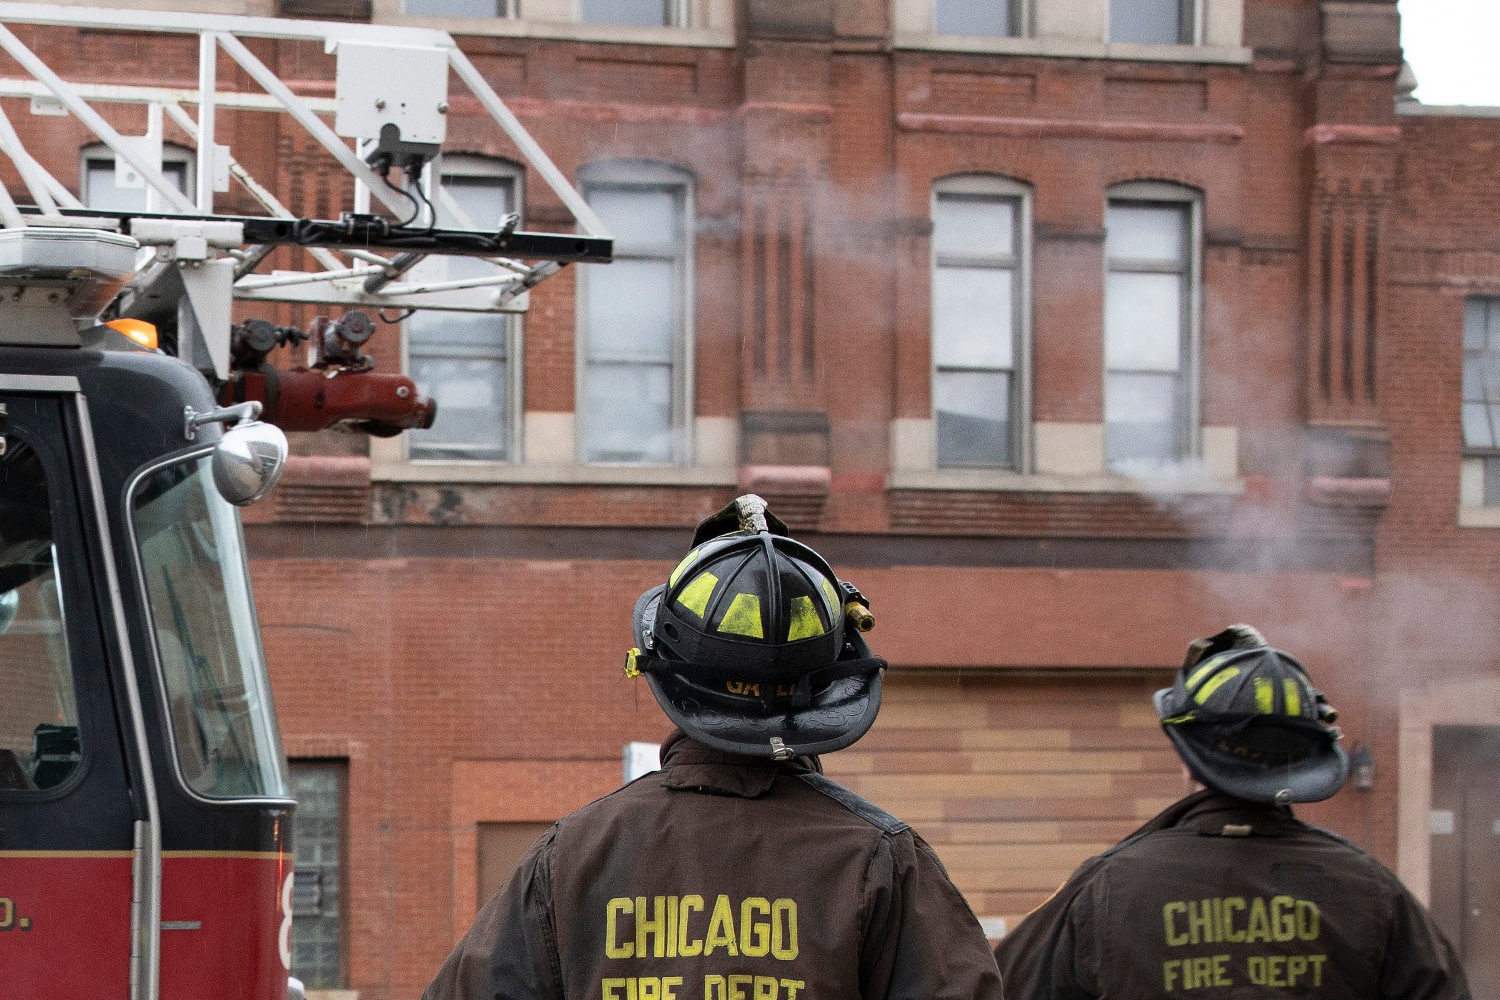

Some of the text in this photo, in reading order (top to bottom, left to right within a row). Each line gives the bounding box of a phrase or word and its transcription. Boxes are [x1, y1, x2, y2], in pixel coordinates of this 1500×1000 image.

[605, 894, 799, 961] CHICAGO
[1163, 895, 1321, 947] CHICAGO
[1163, 954, 1328, 993] FIRE DEPT
